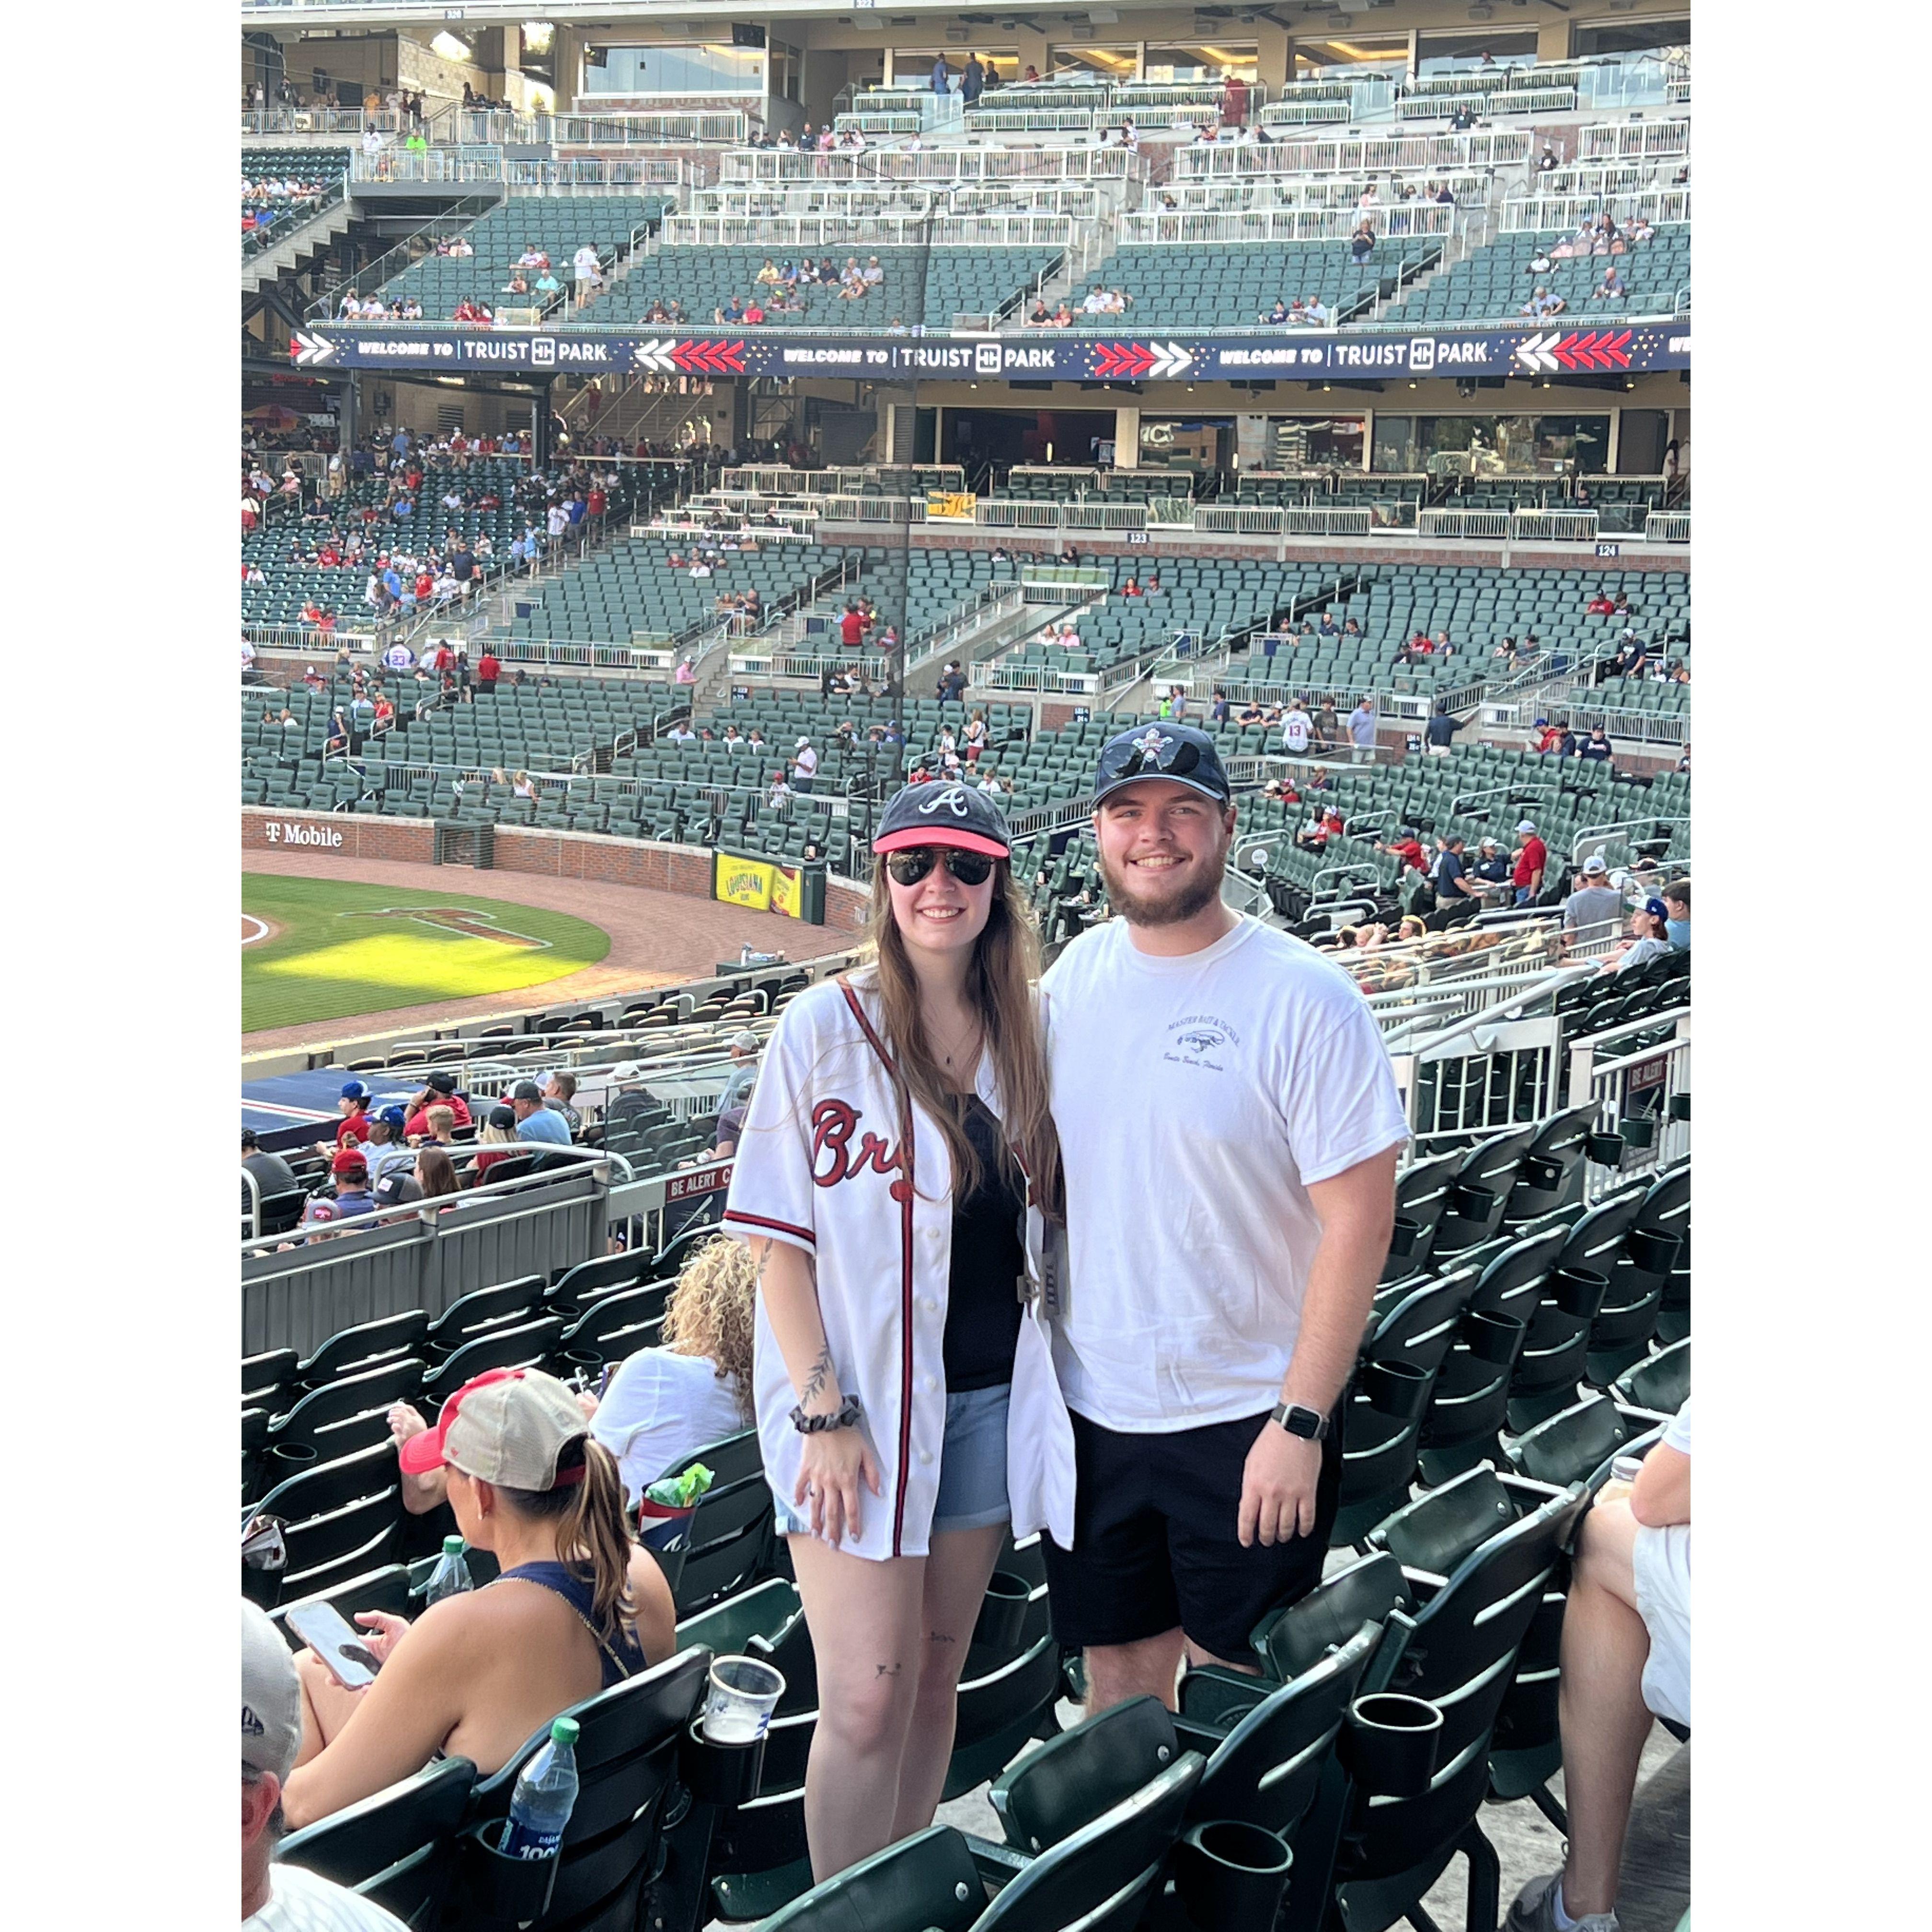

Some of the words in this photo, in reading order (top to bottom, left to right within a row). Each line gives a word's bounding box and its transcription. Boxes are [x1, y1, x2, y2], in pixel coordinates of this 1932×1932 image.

[358, 341, 430, 356] WELCOME
[433, 342, 453, 356] TO
[464, 341, 529, 360] TRUIST
[559, 343, 607, 361] PARK
[783, 349, 862, 364] WELCOME
[866, 349, 888, 364] TO
[900, 348, 971, 367] TRUIST
[1005, 350, 1056, 368] PARK
[1219, 349, 1297, 365] WELCOME
[1301, 349, 1323, 363] TO
[1335, 344, 1405, 365] TRUIST
[1438, 341, 1487, 363] PARK
[1131, 534, 1146, 543] 123
[1599, 546, 1615, 556] 124
[392, 655, 404, 666] 23
[1289, 725, 1301, 736] 13
[918, 787, 968, 817] A
[671, 1179, 685, 1196] BE
[686, 1172, 716, 1193] ALERT
